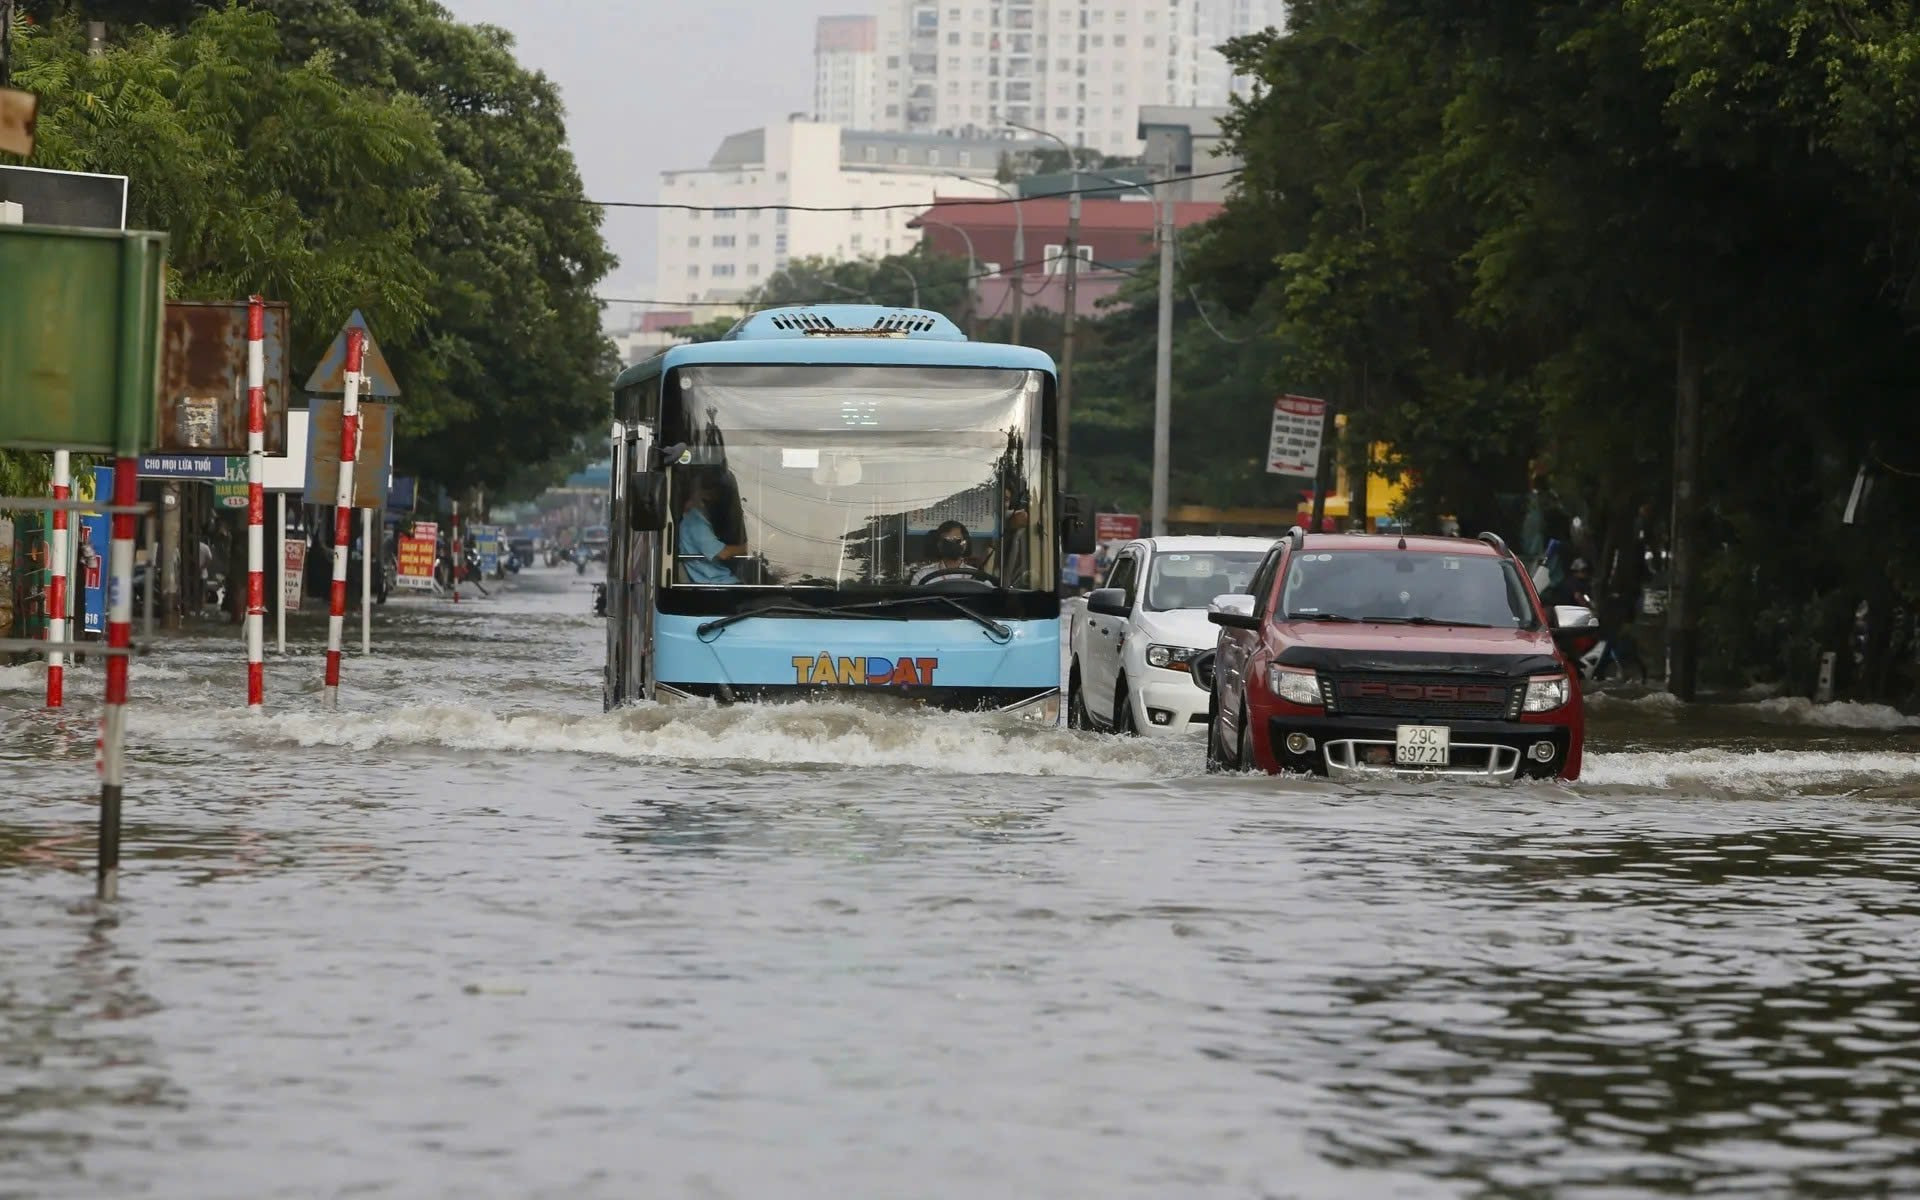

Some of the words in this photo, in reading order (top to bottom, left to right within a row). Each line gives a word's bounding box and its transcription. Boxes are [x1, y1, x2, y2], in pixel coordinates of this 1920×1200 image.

[144, 458, 161, 470] CHO
[161, 458, 177, 473] MỌI
[1409, 728, 1438, 745] 29C
[1398, 746, 1446, 763] 397.21
